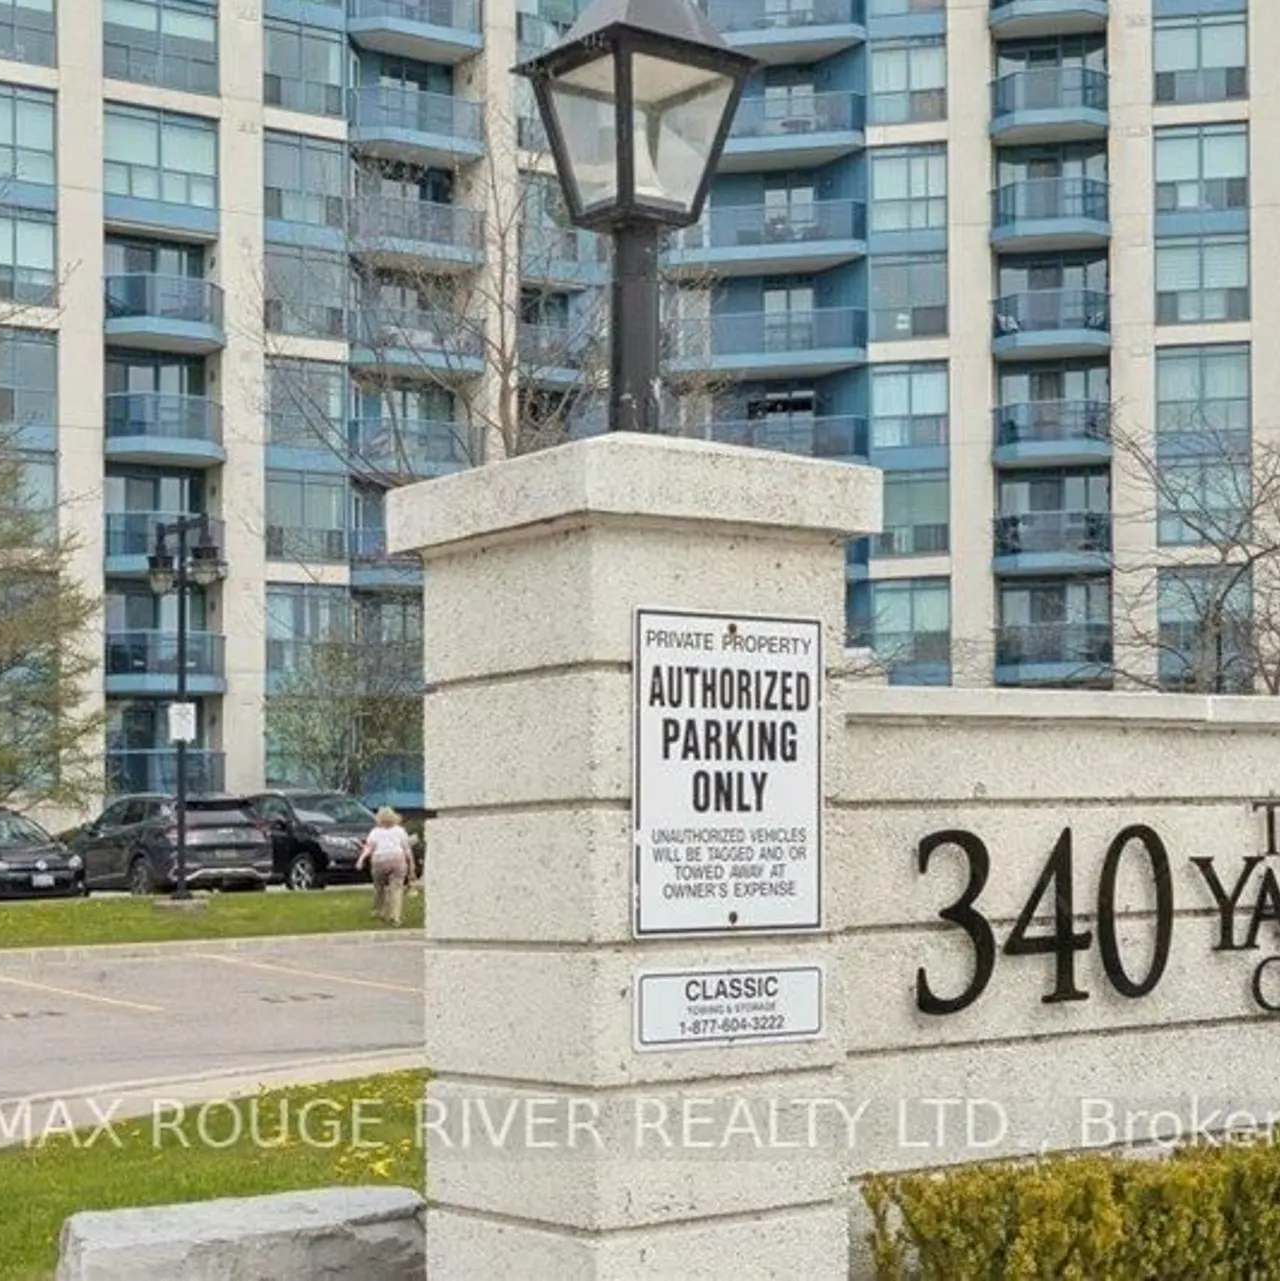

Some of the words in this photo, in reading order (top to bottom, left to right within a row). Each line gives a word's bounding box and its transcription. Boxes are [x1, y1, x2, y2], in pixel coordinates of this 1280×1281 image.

[646, 630, 714, 651] PRIVATE
[722, 634, 812, 655] PROPERTY
[649, 665, 810, 711] AUTHORIZED
[662, 719, 797, 763] PARKING
[692, 770, 768, 812] ONLY
[652, 828, 746, 844] UNAUTHORIZED
[750, 828, 807, 843] VEHICLES
[652, 847, 681, 862] WILL
[686, 846, 702, 862] BE
[708, 846, 754, 862] TAGGED
[759, 846, 784, 861] AND
[789, 846, 807, 861] OR
[674, 864, 725, 880] TOWED
[729, 864, 764, 879] AWAY
[770, 864, 787, 878] AT
[663, 882, 728, 900] OWNER'S
[734, 881, 797, 898] EXPENSE
[917, 823, 1175, 1015] 340
[685, 976, 779, 1001] CLASSIC
